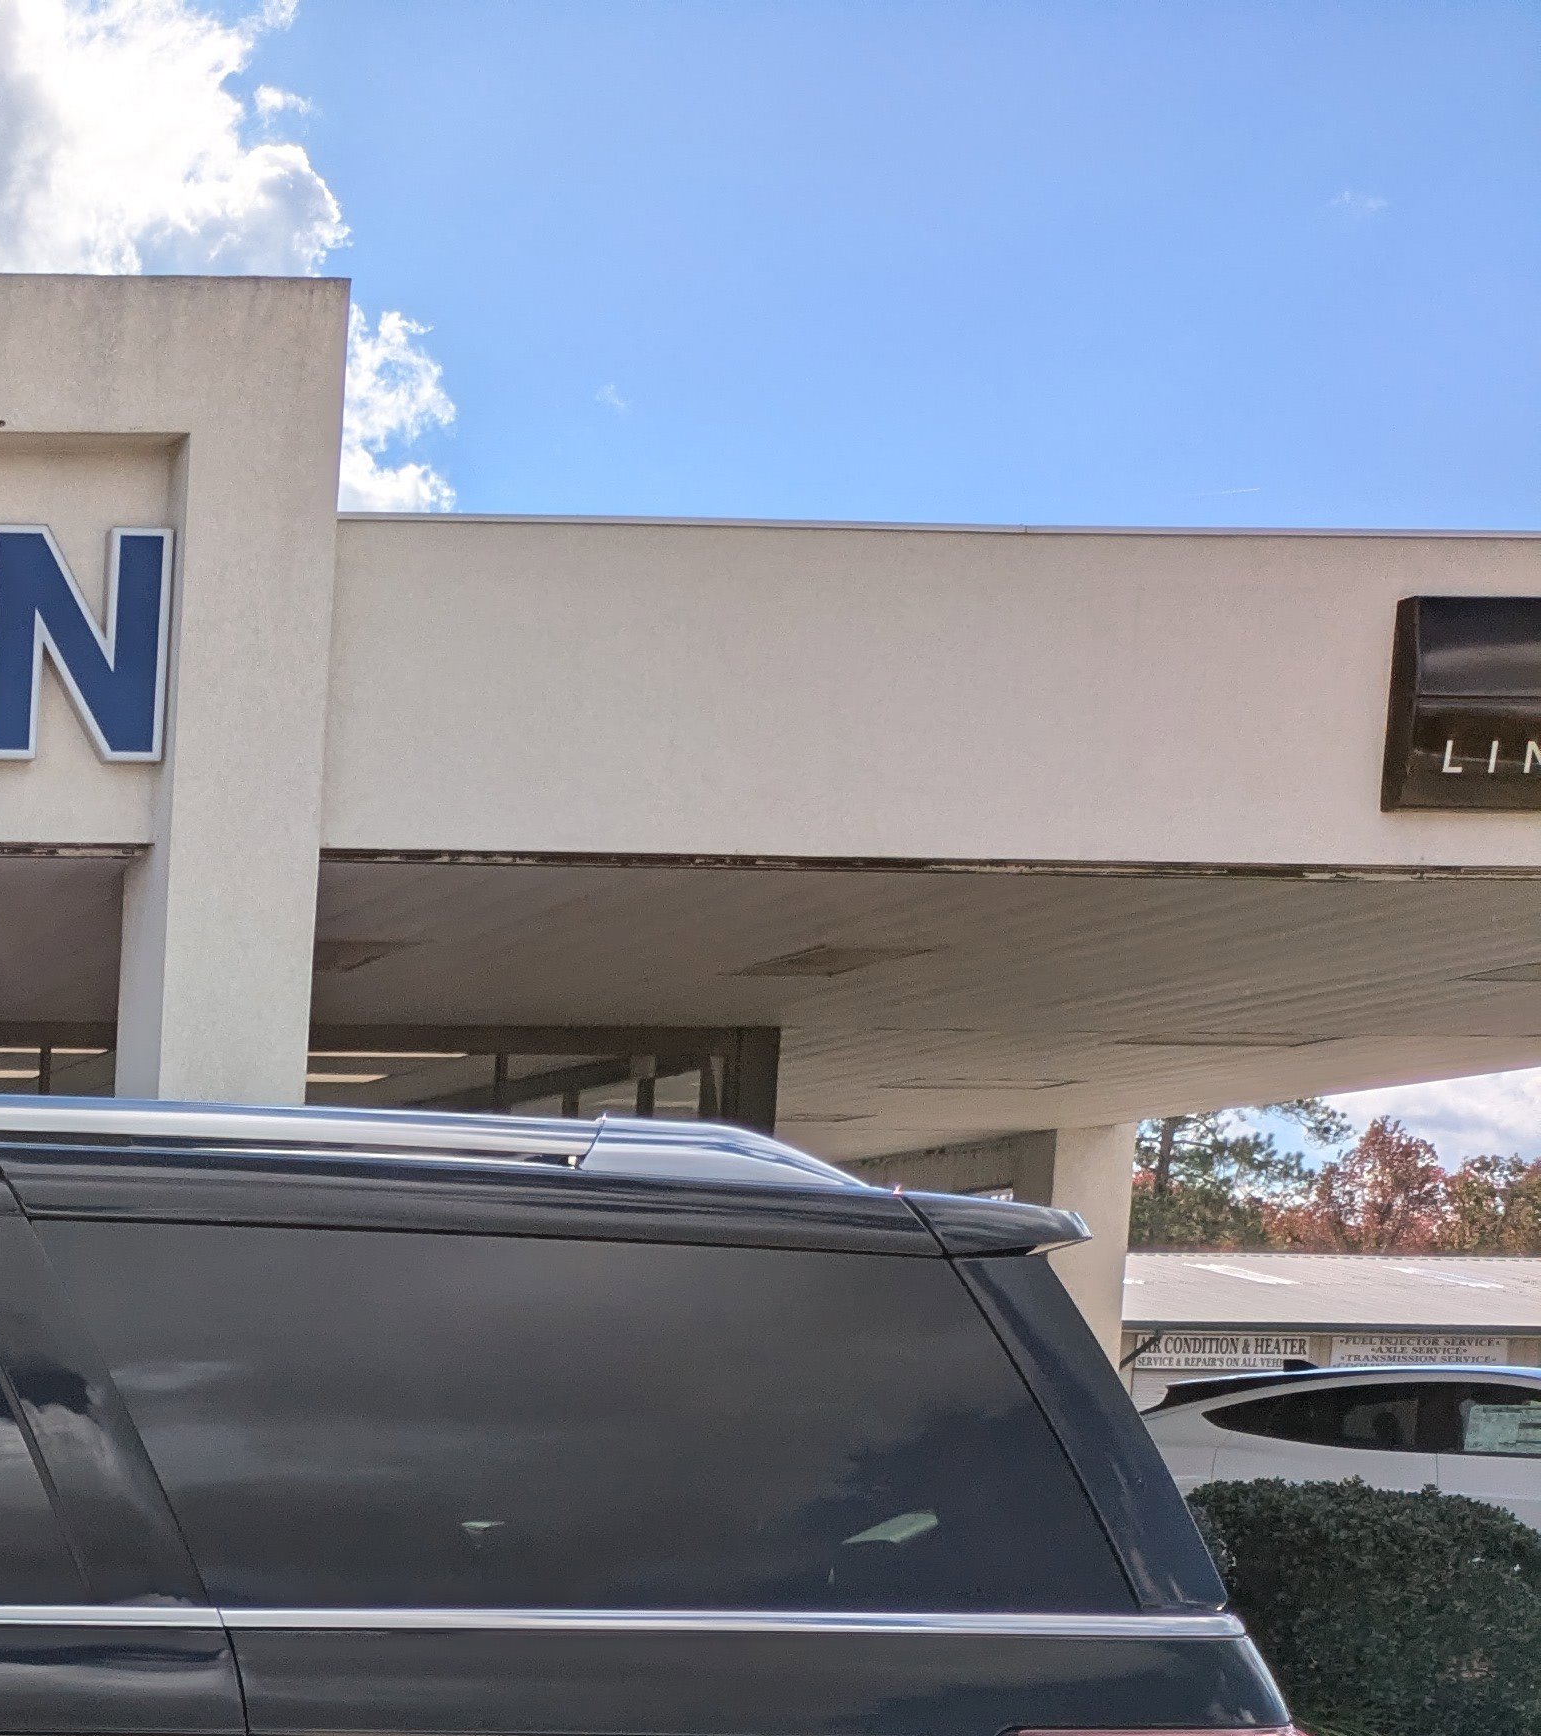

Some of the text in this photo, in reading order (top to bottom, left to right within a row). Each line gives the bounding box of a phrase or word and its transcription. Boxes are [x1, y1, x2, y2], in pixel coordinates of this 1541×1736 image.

[1163, 1336, 1240, 1355] CONDITION
[1241, 1337, 1251, 1354] &
[1254, 1337, 1307, 1356] HEATER
[1378, 1336, 1439, 1347] INJECTOR
[1136, 1355, 1174, 1367] SERVICE
[1175, 1357, 1182, 1367] &
[1184, 1356, 1225, 1368] REPAIR'S
[1226, 1357, 1240, 1368] ON
[1241, 1357, 1259, 1368] ALL
[1345, 1354, 1438, 1363] TRANSMISSION
